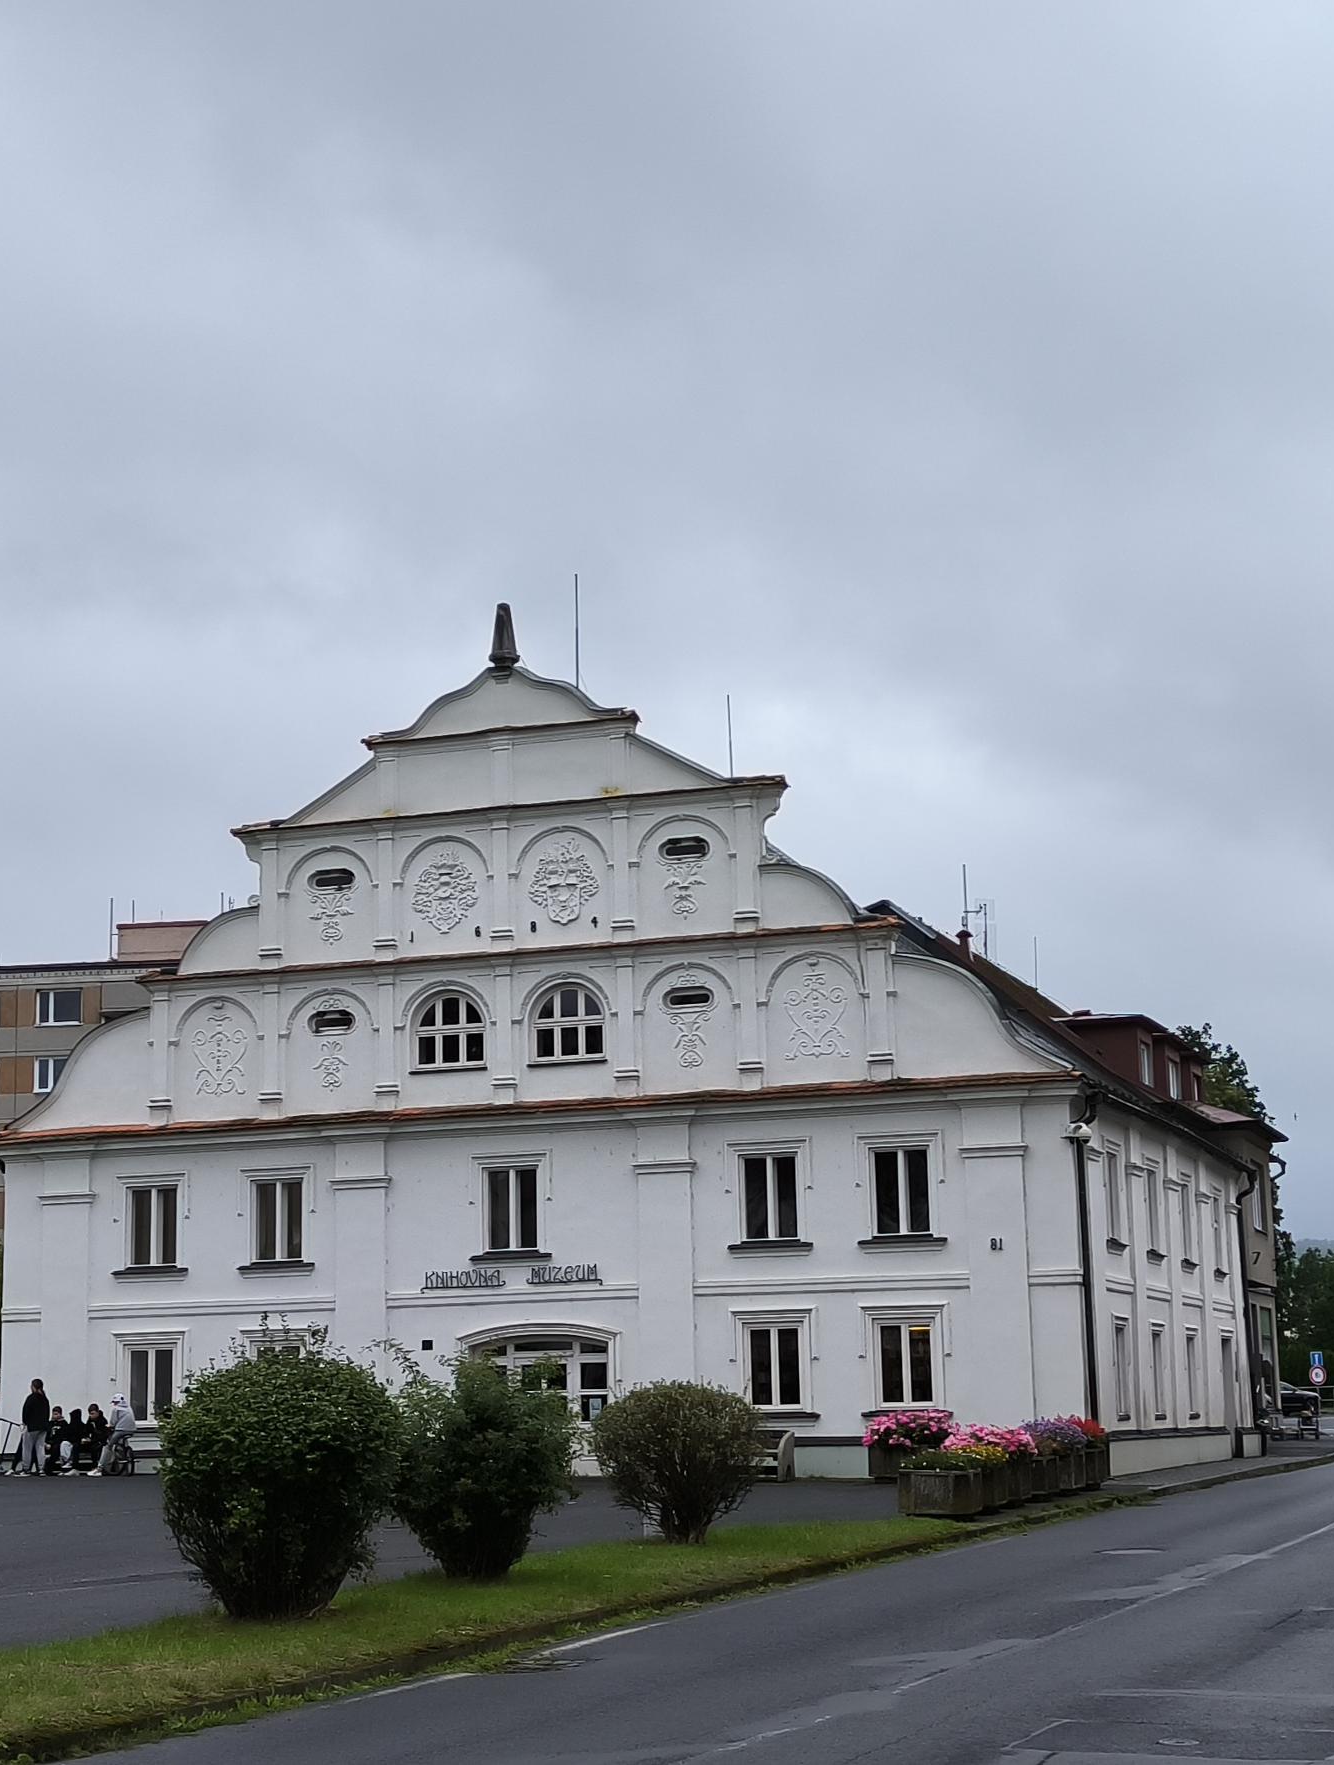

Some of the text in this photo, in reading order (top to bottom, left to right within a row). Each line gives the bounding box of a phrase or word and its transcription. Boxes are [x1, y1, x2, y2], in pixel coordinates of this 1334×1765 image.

[475, 926, 481, 937] 6
[530, 921, 537, 933] 8
[591, 916, 598, 928] 4
[990, 1238, 1003, 1251] 81
[1251, 1251, 1261, 1265] 7
[425, 1263, 598, 1288] KNIHOVNA MUZEUM
